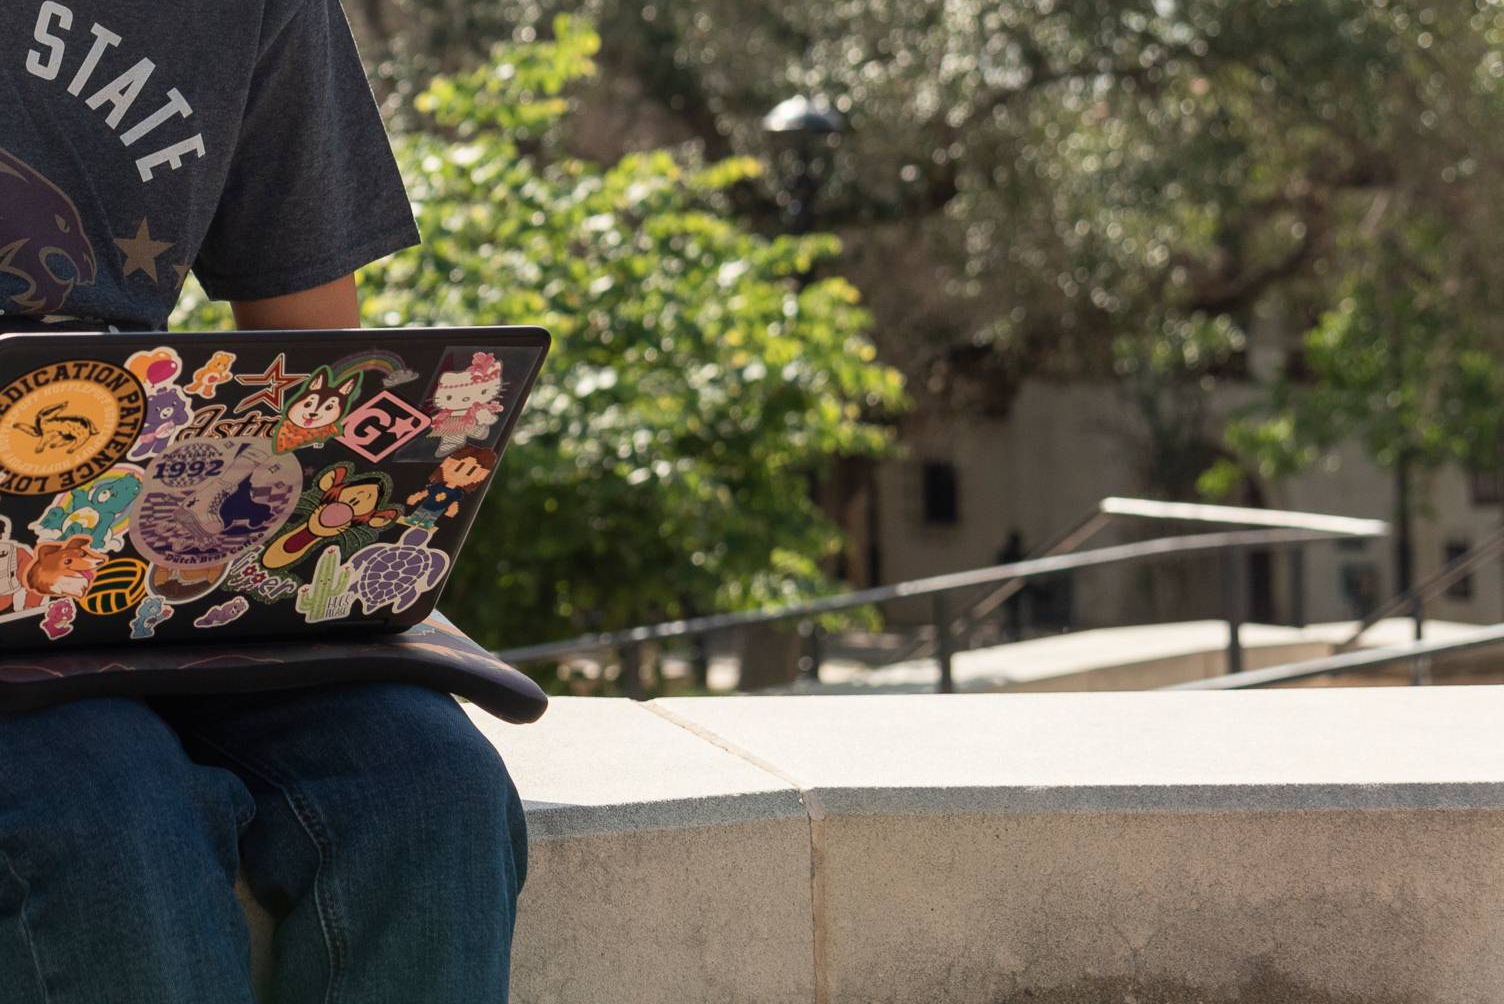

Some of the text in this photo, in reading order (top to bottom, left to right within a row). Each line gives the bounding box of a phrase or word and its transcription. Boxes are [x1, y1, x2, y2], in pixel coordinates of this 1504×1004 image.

[25, 0, 206, 183] STATE
[59, 392, 142, 489] PATIENCE
[152, 459, 225, 480] 1992
[164, 532, 265, 564] Dutch Bros Coffee
